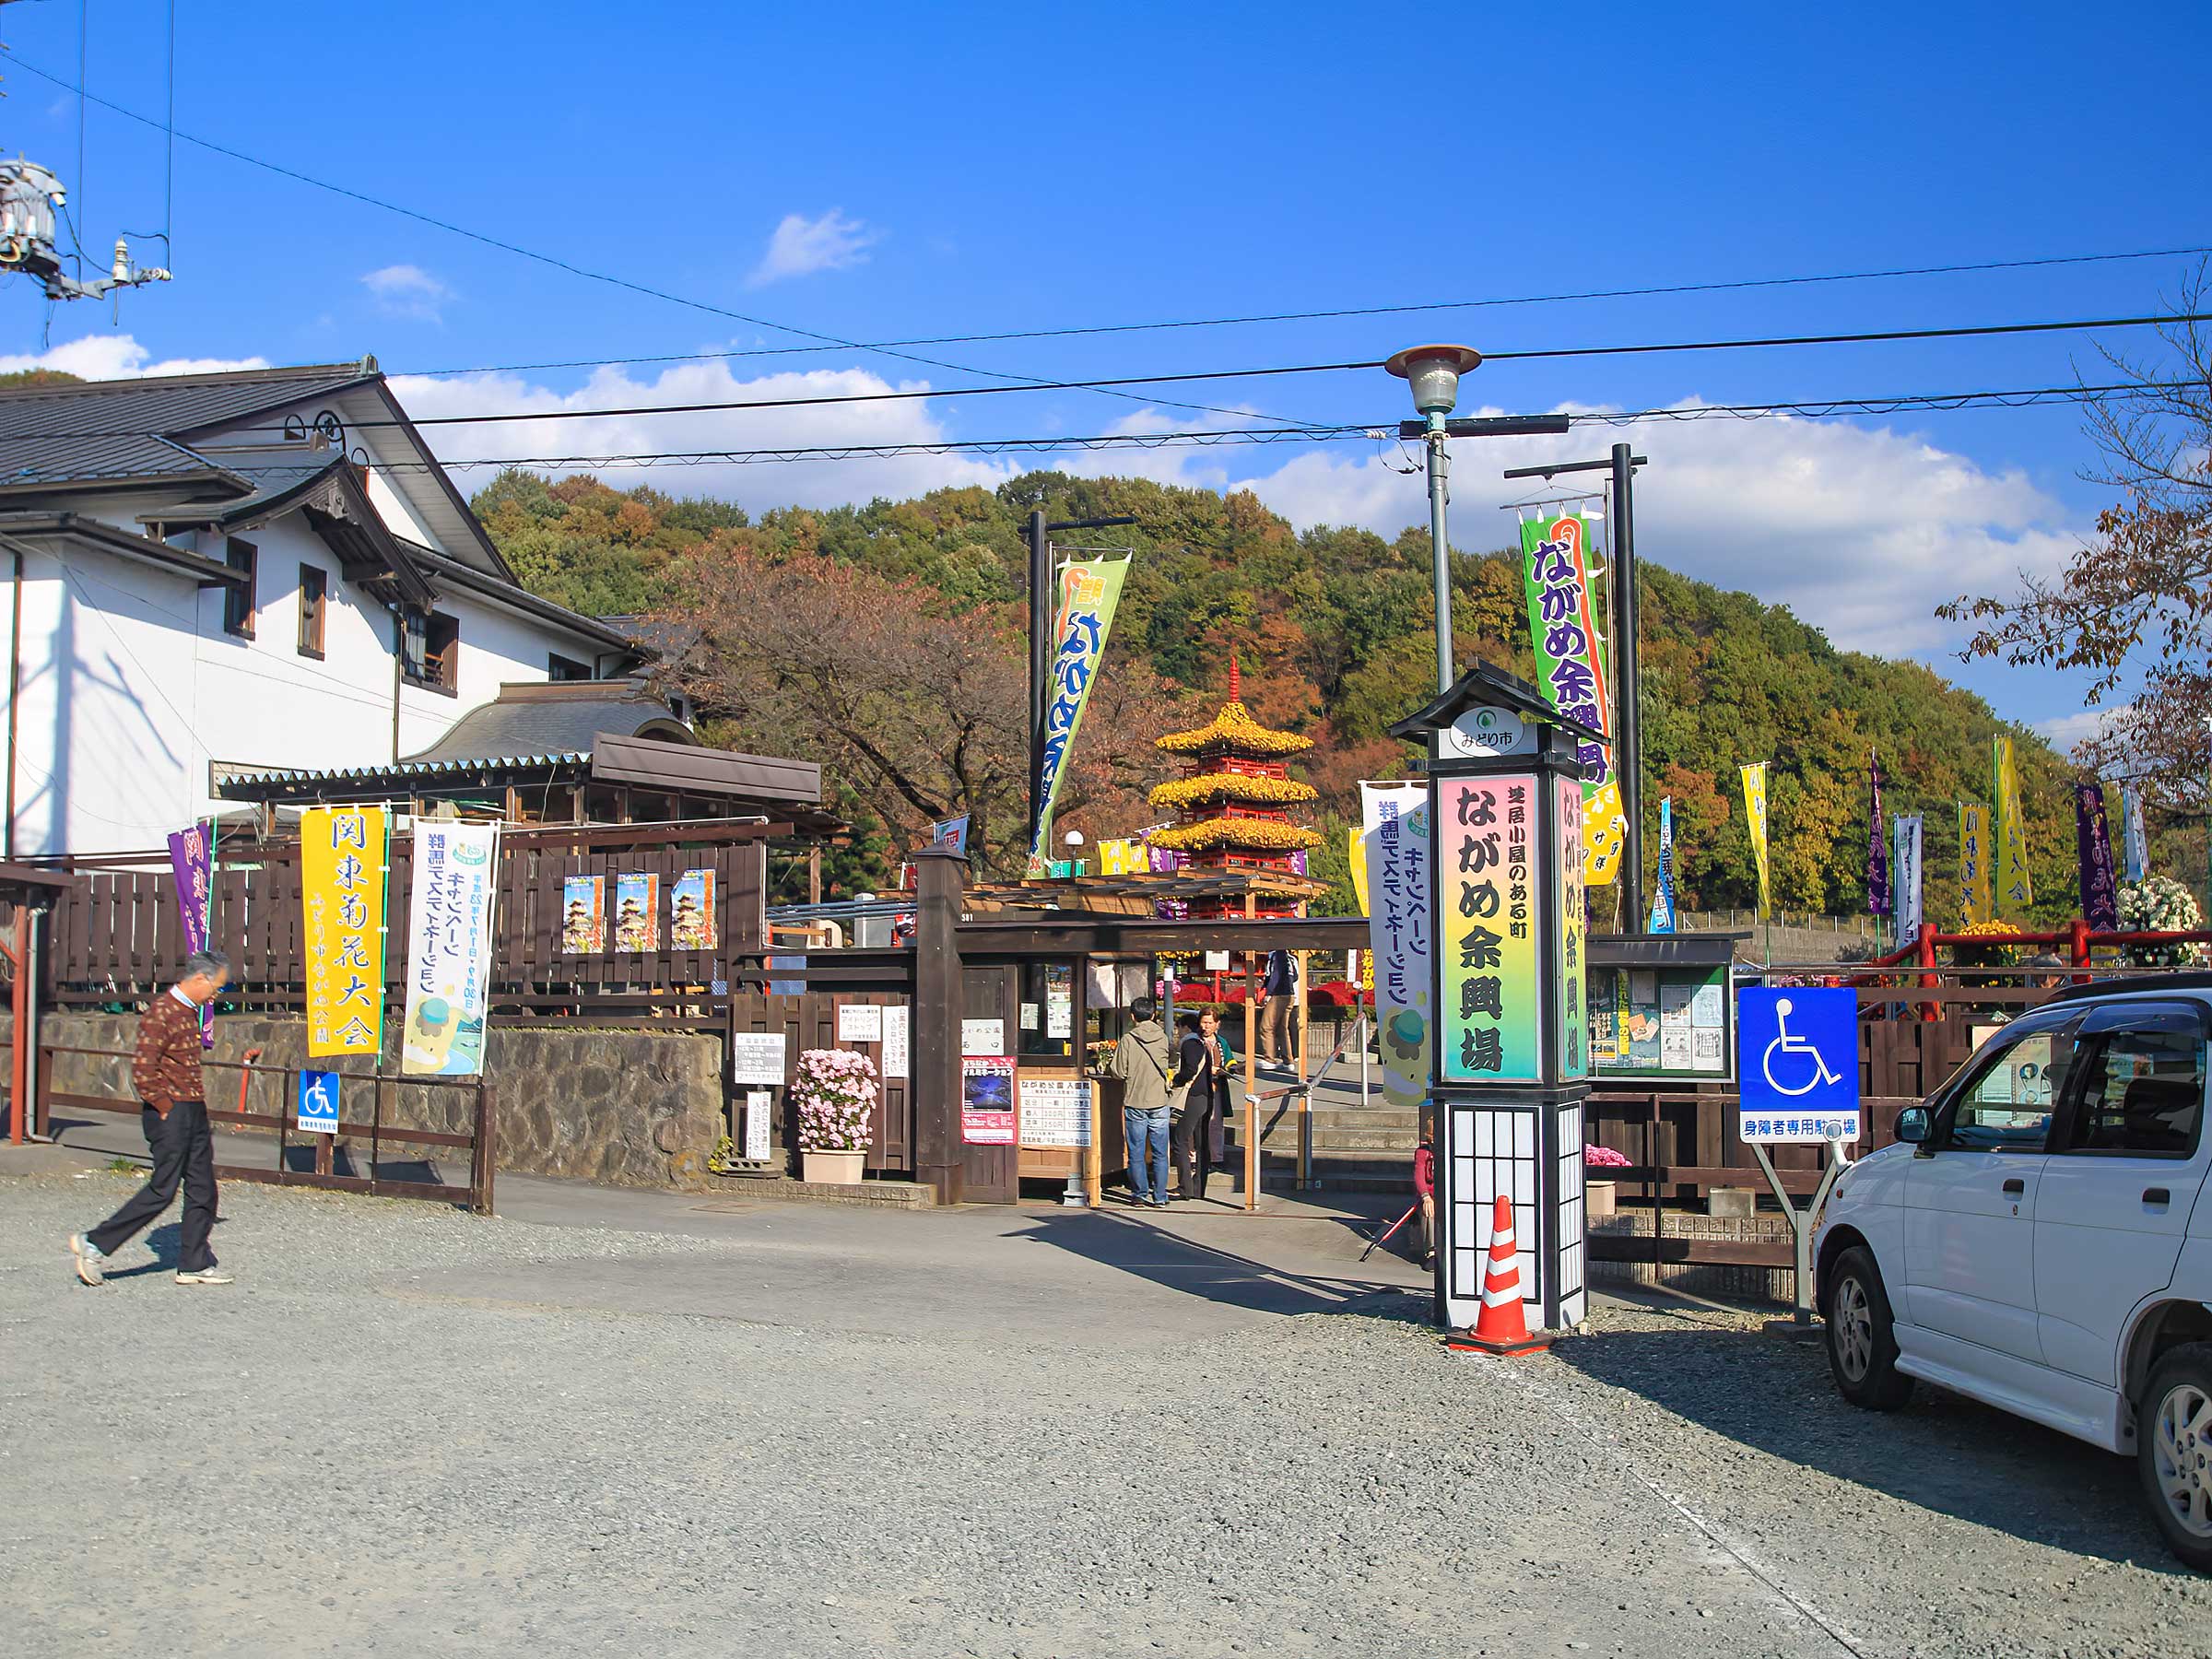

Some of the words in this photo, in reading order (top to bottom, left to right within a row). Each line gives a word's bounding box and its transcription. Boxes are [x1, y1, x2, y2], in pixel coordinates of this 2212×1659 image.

[1461, 731, 1513, 748] みどり市
[331, 814, 374, 1046] 関東菊花大会
[1456, 786, 1503, 1072] ながめ余興場
[1508, 785, 1527, 939] 芝居小屋のある町
[1563, 787, 1579, 1070] ながめ余興場
[1744, 1118, 1856, 1136] 身障者専用駐場
